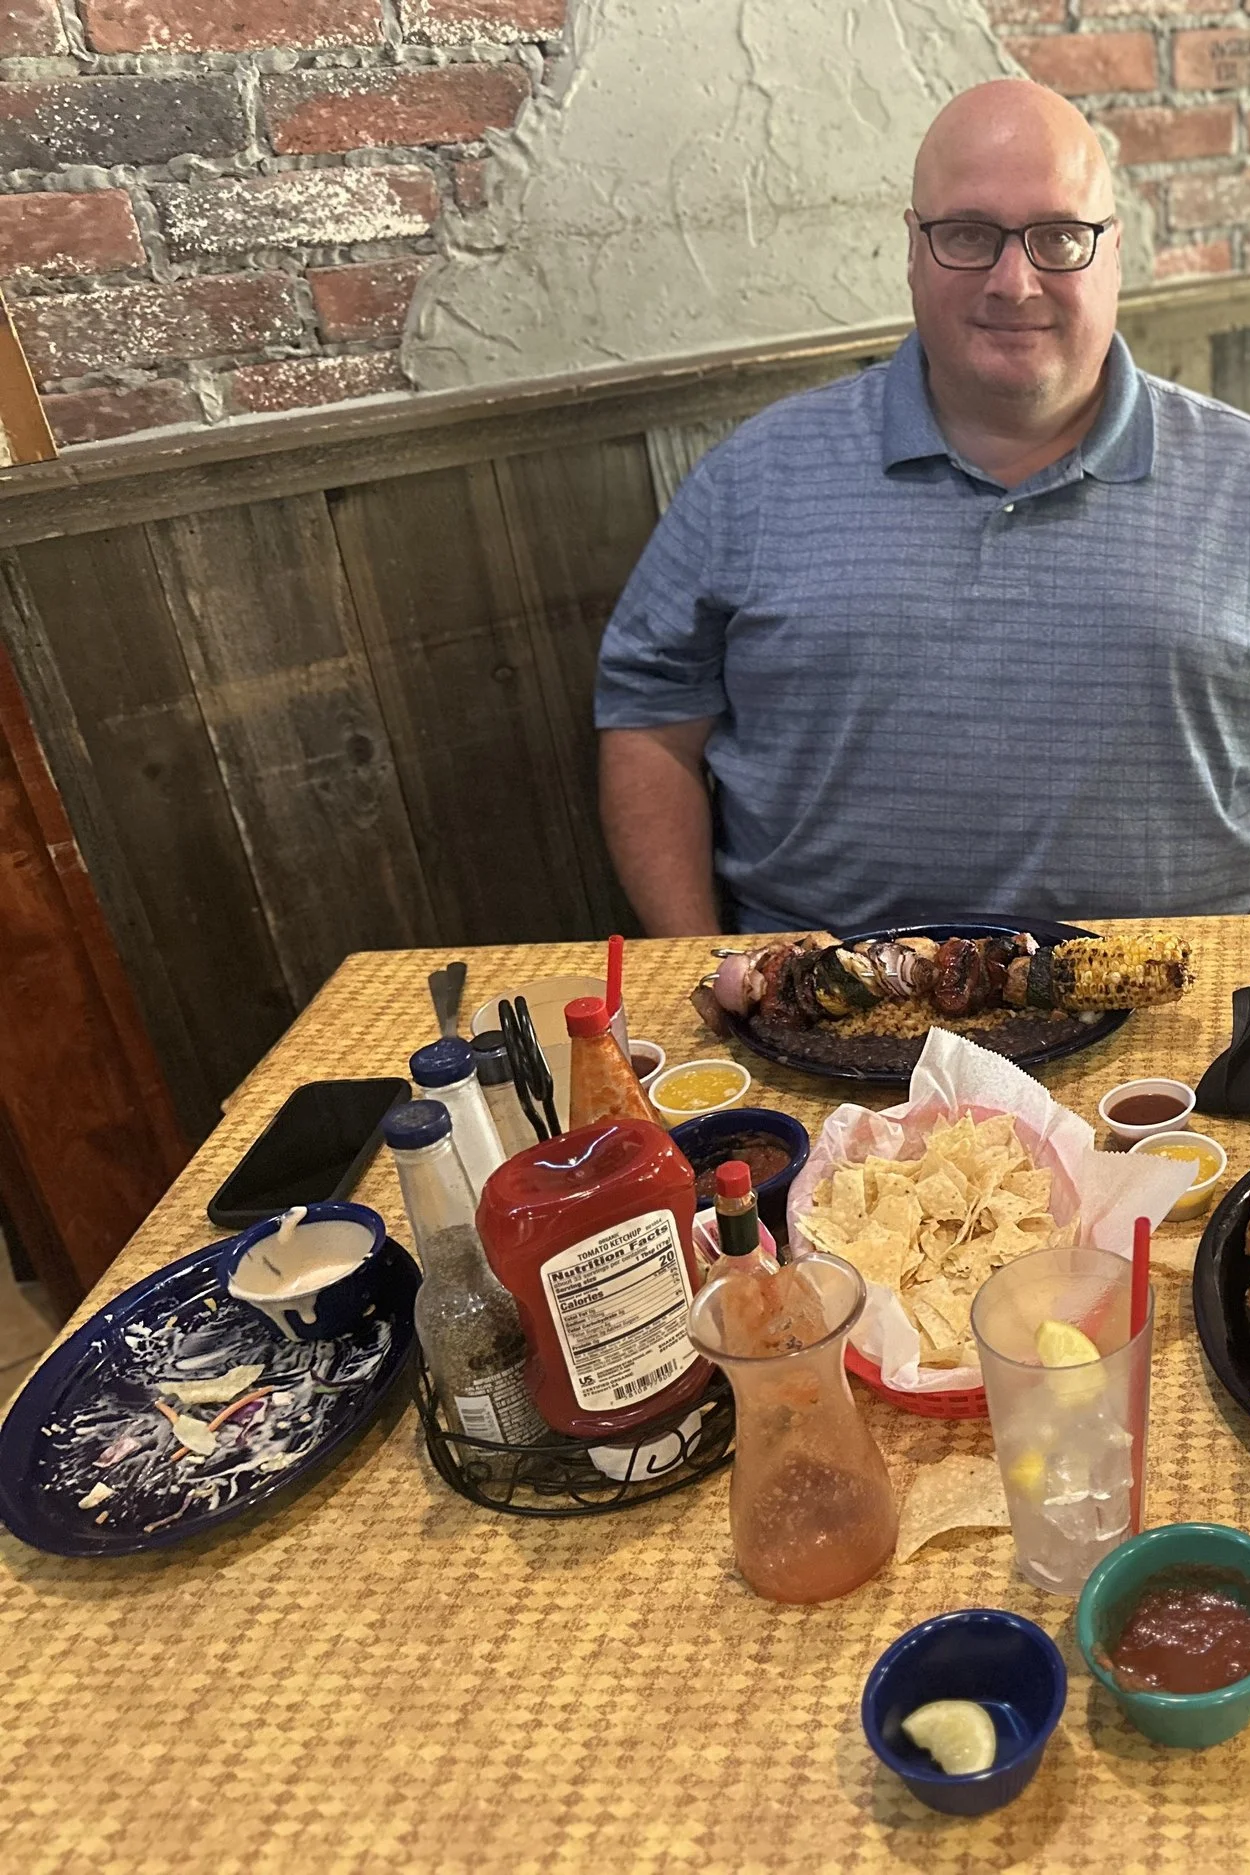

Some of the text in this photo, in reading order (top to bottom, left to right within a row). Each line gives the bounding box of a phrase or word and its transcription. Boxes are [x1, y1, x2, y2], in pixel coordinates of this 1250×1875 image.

[551, 1248, 625, 1281] Nutrition
[629, 1225, 668, 1251] Facts
[577, 1227, 642, 1261] TOMATO KETCHUP
[641, 1248, 655, 1260] Tbsp
[659, 1250, 675, 1267] 20
[555, 1276, 597, 1294] Serving size
[560, 1291, 604, 1311] Calories
